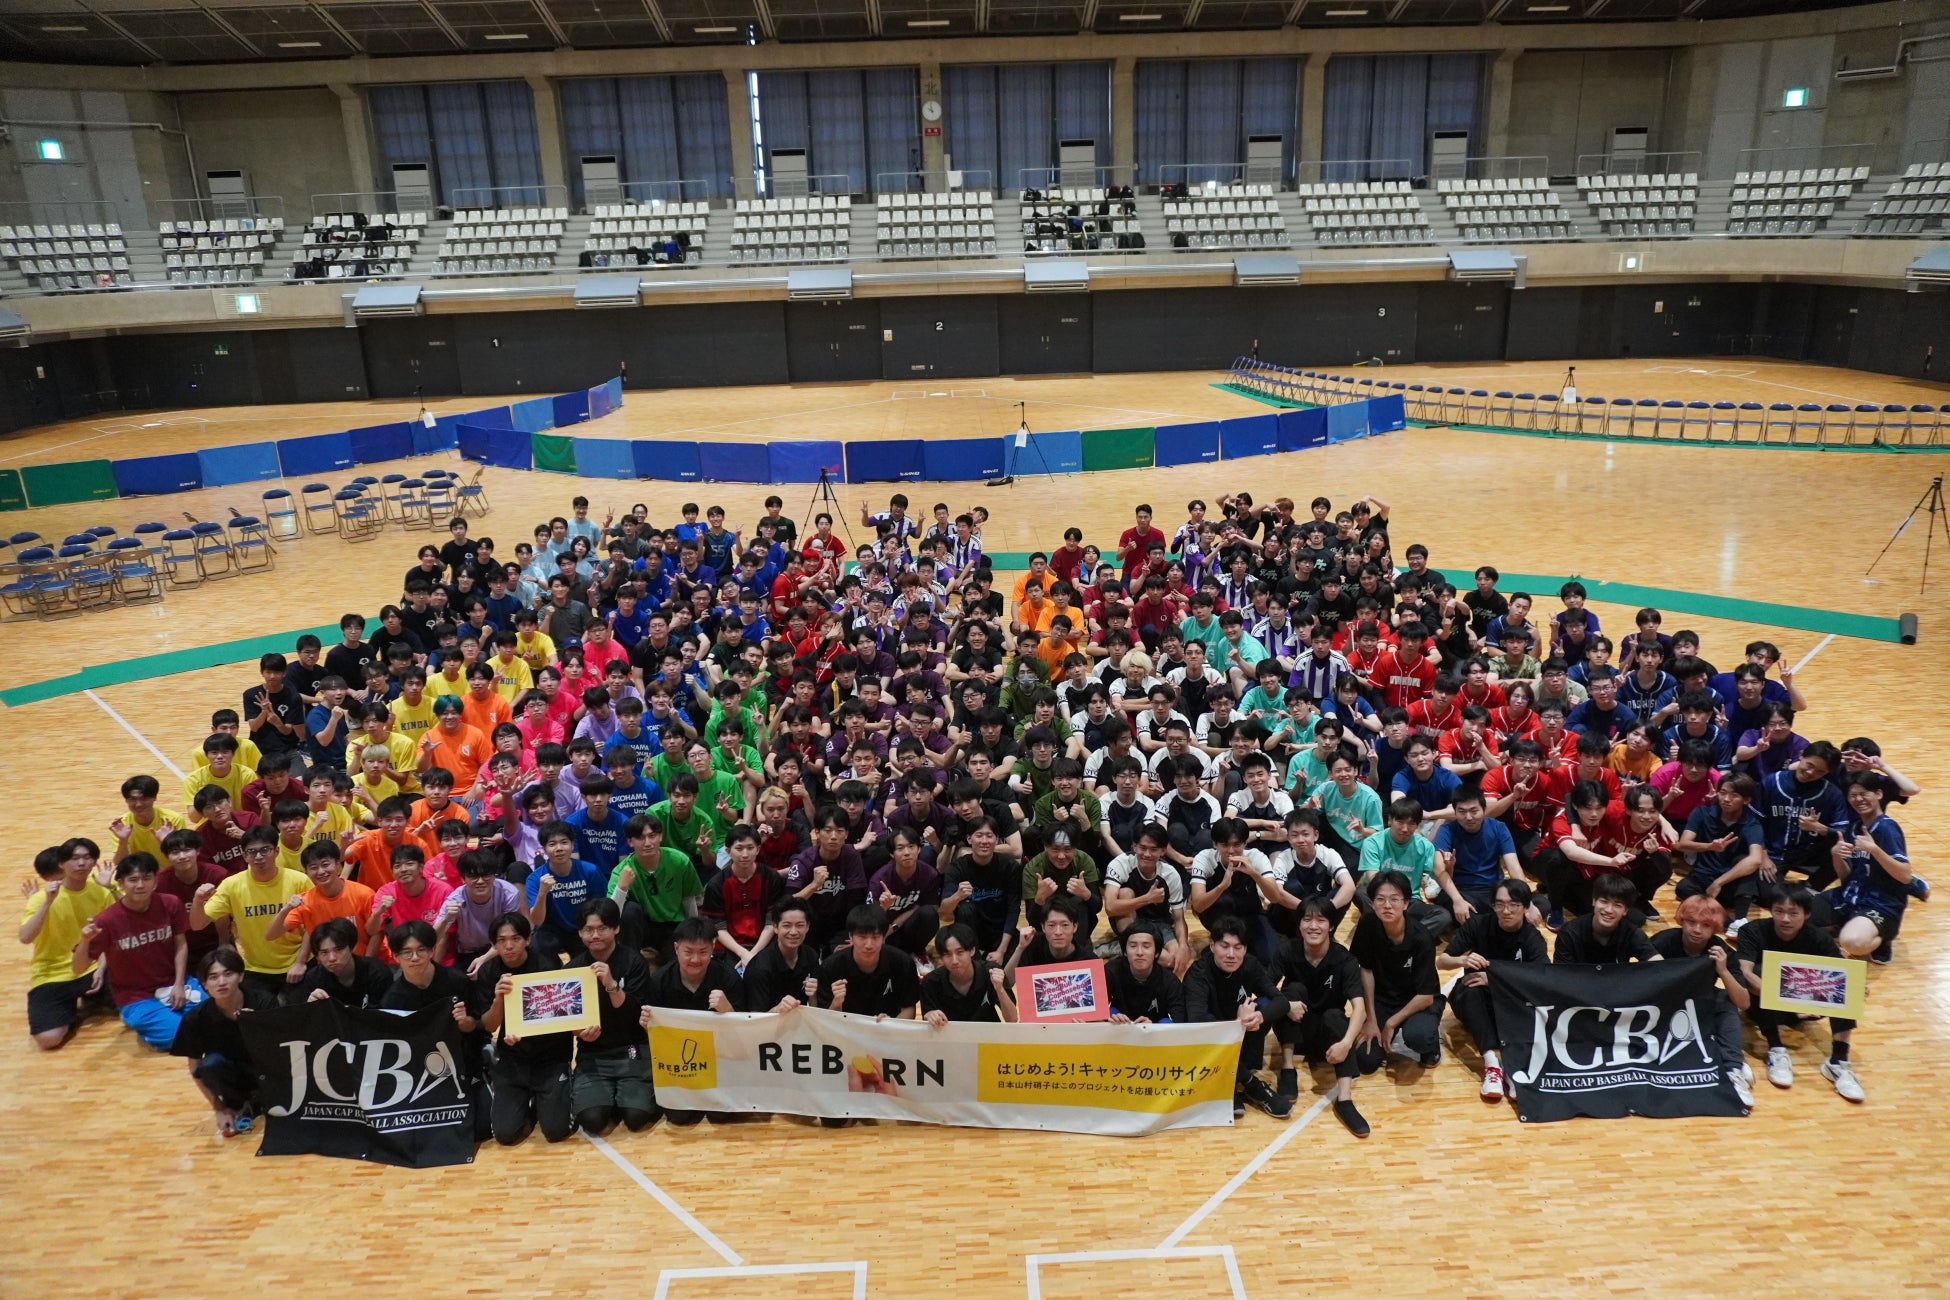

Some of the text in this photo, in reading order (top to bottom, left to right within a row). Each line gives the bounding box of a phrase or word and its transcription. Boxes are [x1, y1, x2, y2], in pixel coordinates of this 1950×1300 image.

[1378, 308, 1386, 317] 3
[936, 322, 944, 330] 2
[492, 338, 499, 347] 1
[401, 721, 429, 731] KINDA
[212, 845, 244, 863] WASE
[245, 903, 286, 918] KINDA
[118, 925, 173, 950] WASEDA
[658, 1061, 707, 1073] REBORN
[1540, 1077, 1571, 1089] JAPAN
[1572, 1076, 1595, 1087] CAP
[1650, 1070, 1720, 1085] ASSOCIATION
[302, 1106, 333, 1117] JAPAN
[334, 1107, 354, 1117] CAP
[391, 1108, 469, 1127] ASSOCIATION
